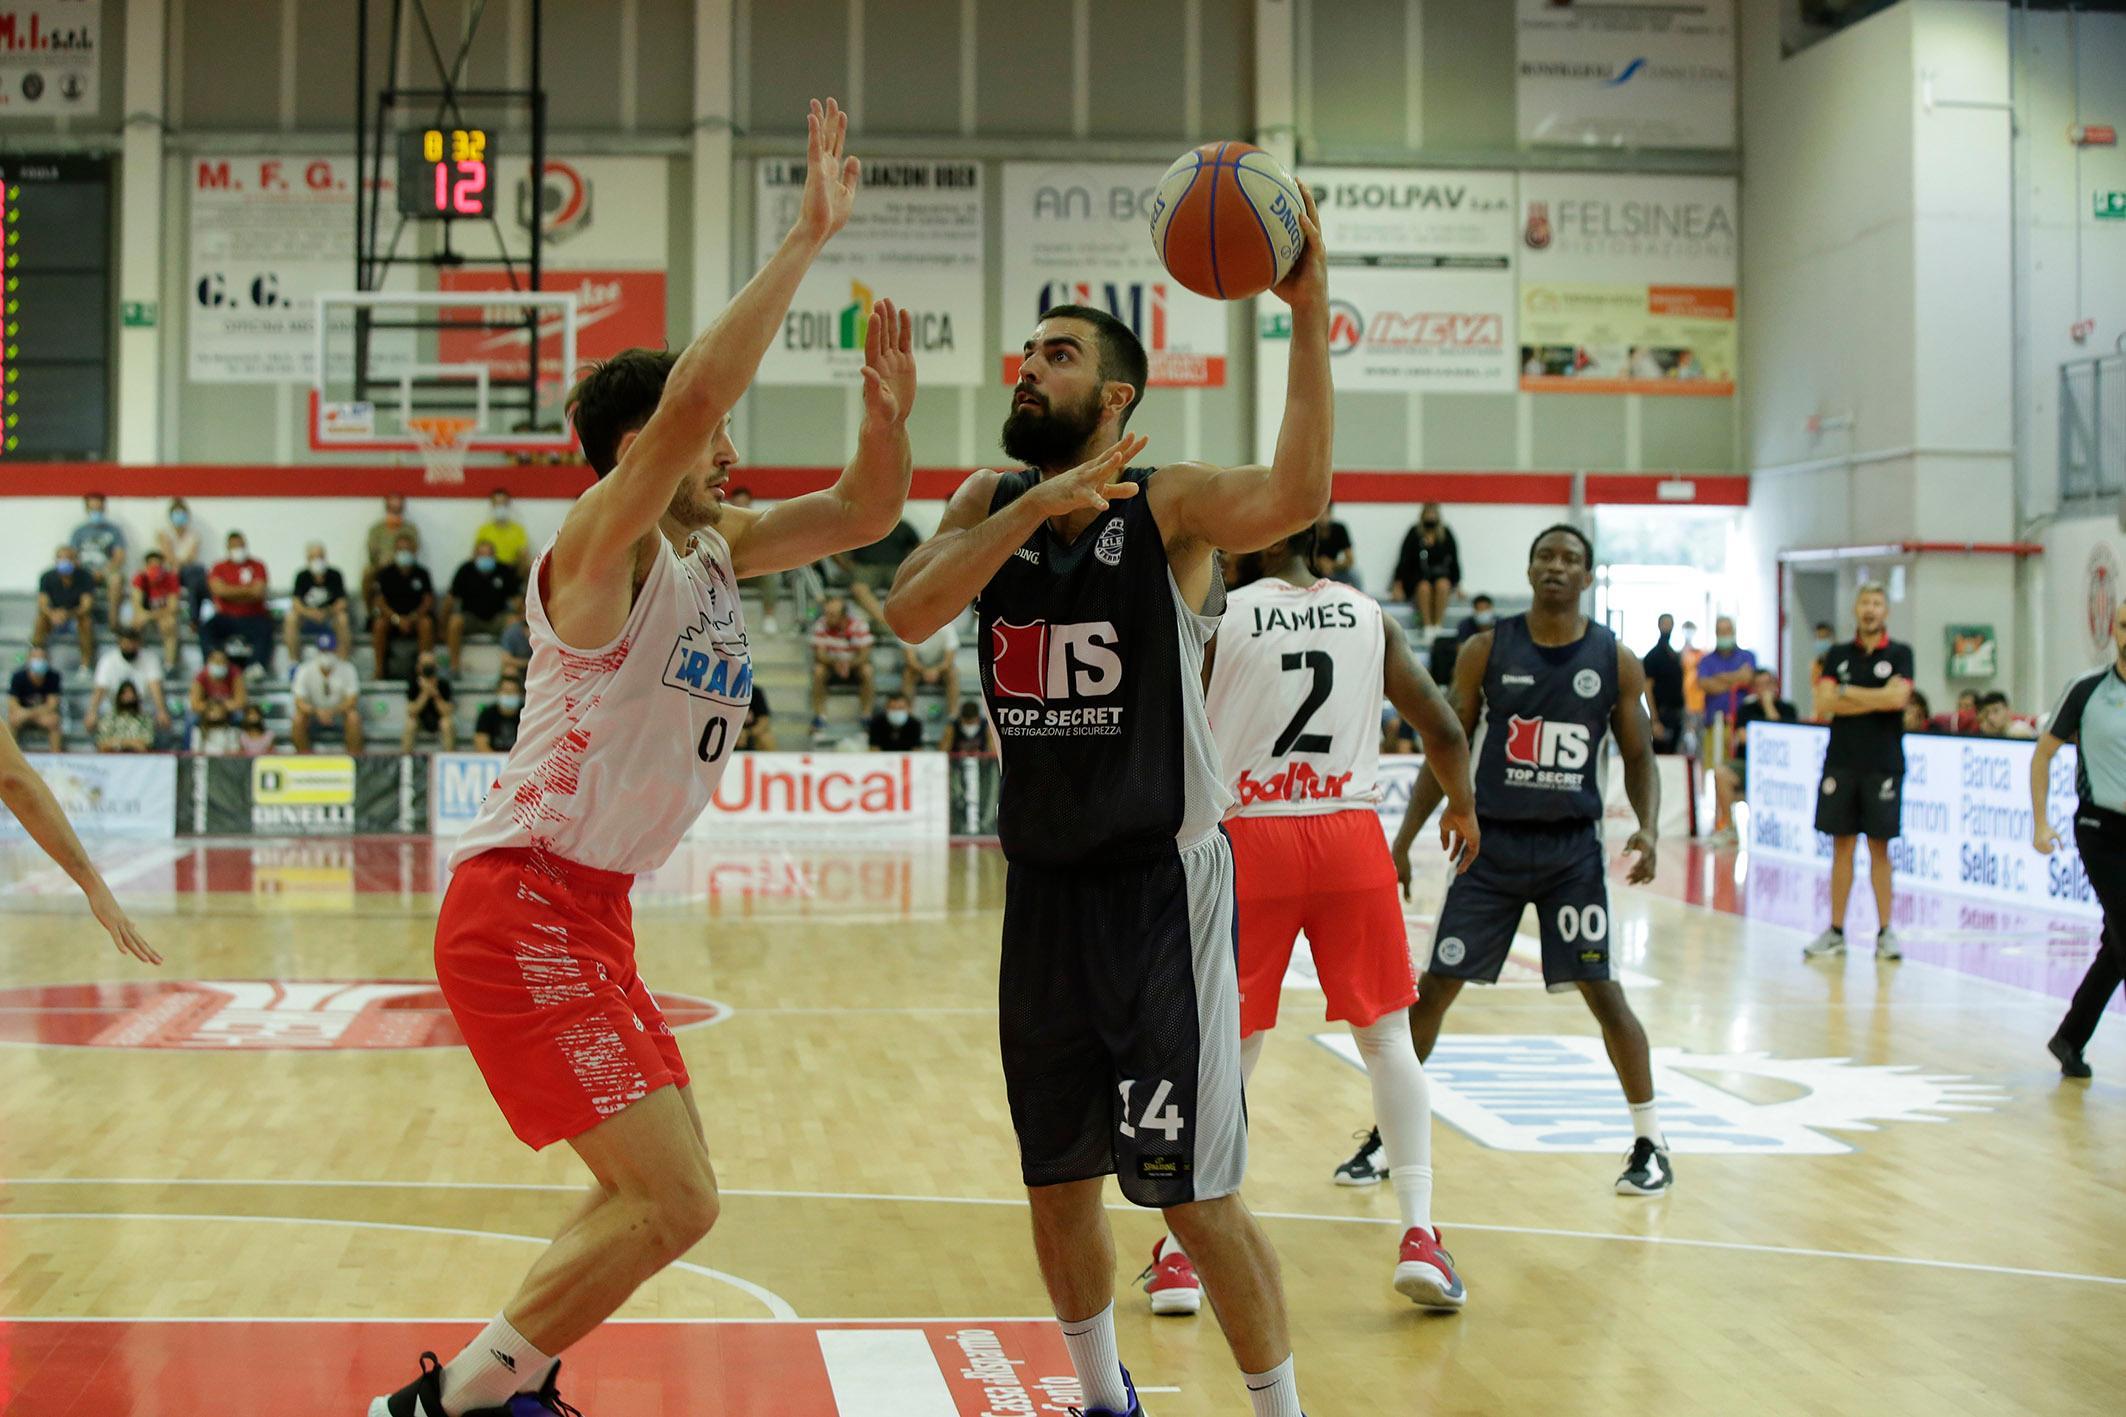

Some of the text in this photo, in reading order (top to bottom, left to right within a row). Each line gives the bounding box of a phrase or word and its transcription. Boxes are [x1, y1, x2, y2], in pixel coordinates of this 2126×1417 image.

[452, 130, 486, 161] 32
[436, 162, 486, 213] 12
[1336, 185, 1465, 208] ISOLPAV
[1558, 201, 1734, 238] FELSINEA
[1252, 604, 1356, 637] JAMES
[998, 707, 1123, 726] TOP SECRET
[1272, 650, 1334, 757] 2
[698, 716, 728, 763] 0
[1073, 726, 1121, 735] SICUREZZA
[712, 757, 911, 813] Unical
[1237, 762, 1353, 806] baltur
[1506, 768, 1584, 784] TOP SECRET
[1963, 746, 2012, 792] Banca
[1961, 841, 1998, 886] Sella
[1558, 894, 1607, 942] 00
[1119, 1080, 1184, 1141] 14
[945, 1329, 1025, 1380] Risparmio
